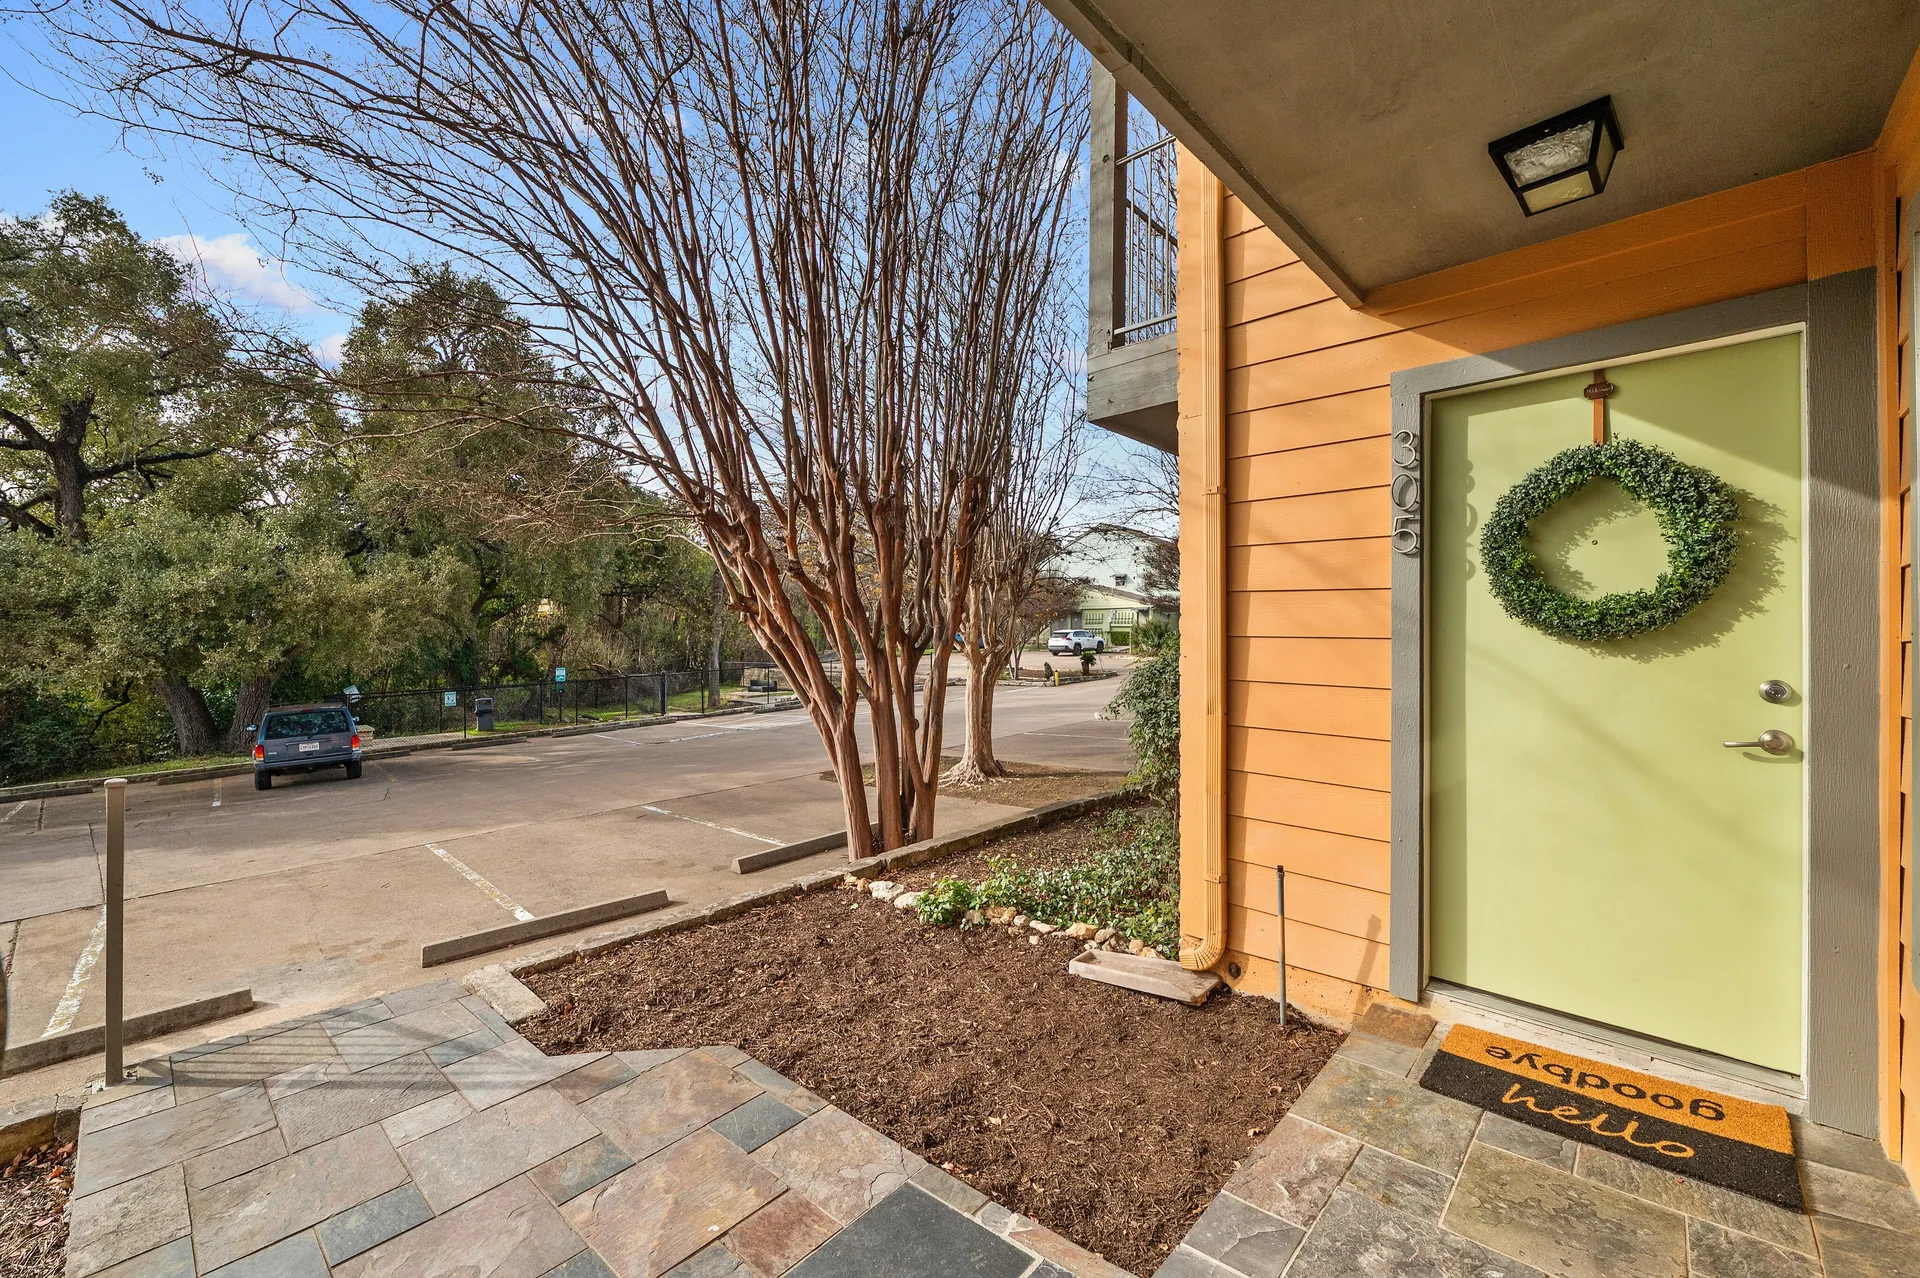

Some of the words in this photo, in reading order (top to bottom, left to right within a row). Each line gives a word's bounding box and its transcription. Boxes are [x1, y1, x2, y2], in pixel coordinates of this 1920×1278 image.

[1391, 429, 1419, 553] 305
[1485, 1045, 1726, 1122] goodbye
[1501, 1082, 1695, 1158] hello
